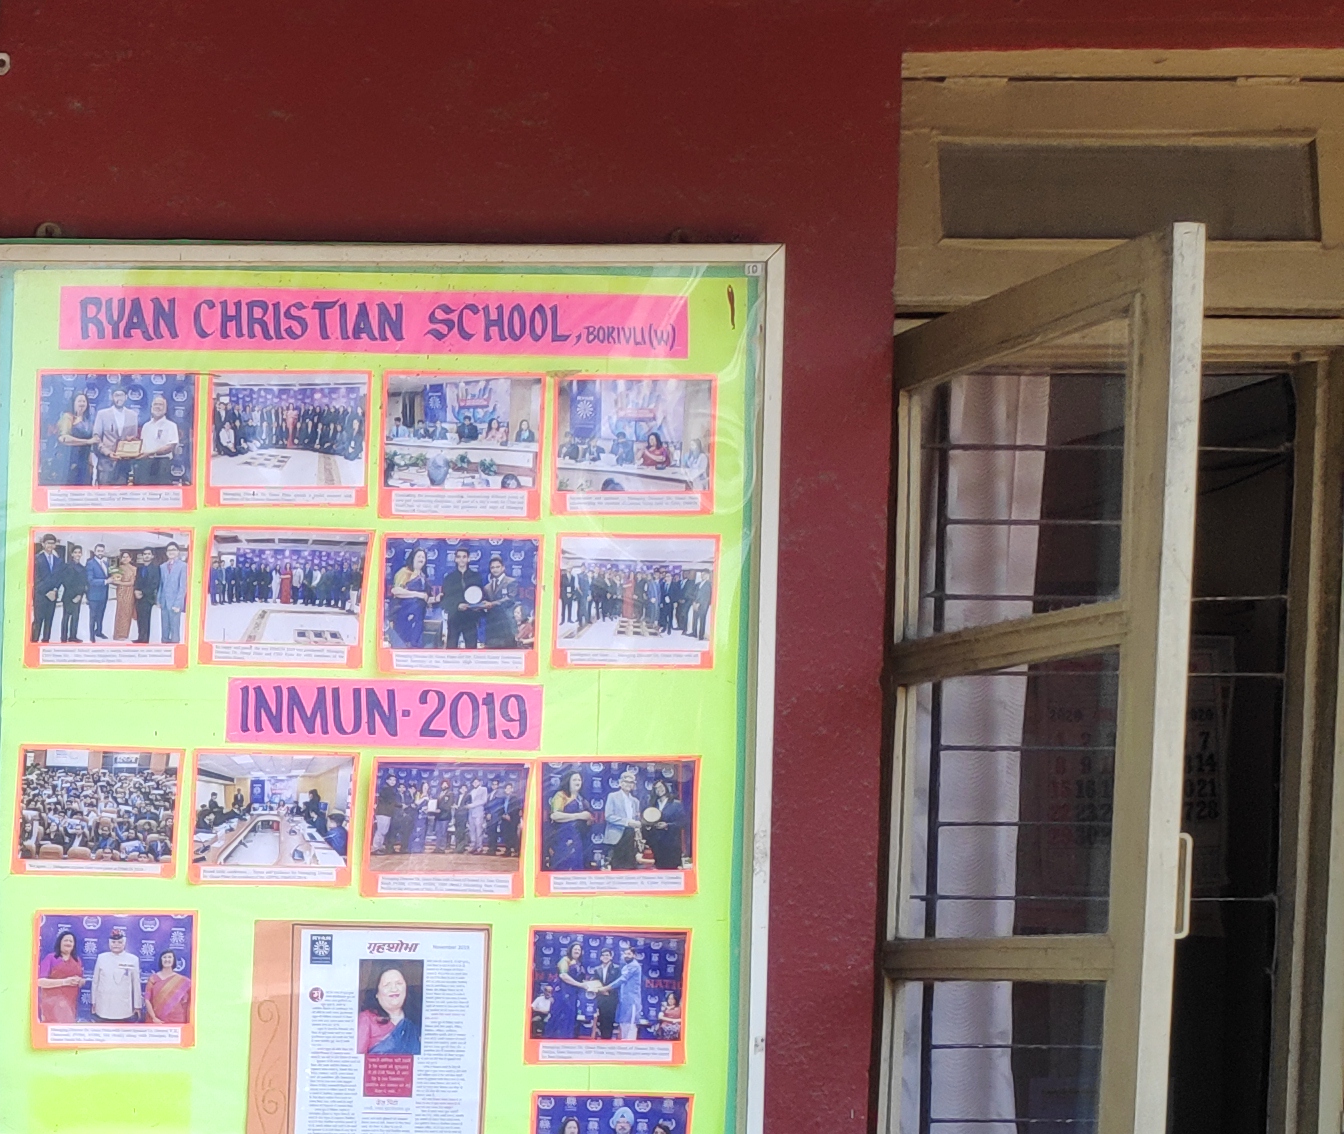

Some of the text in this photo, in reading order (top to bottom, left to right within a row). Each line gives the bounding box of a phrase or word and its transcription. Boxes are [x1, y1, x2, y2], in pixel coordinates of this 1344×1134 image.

[79, 297, 179, 340] RYAN
[193, 298, 405, 341] CHRISTIAN
[1190, 707, 1214, 721] 020
[1199, 730, 1210, 751] 7
[1197, 753, 1217, 773] 14
[1197, 779, 1218, 799] 21
[1196, 800, 1219, 820] 28
[366, 939, 420, 954] गृहशोभा
